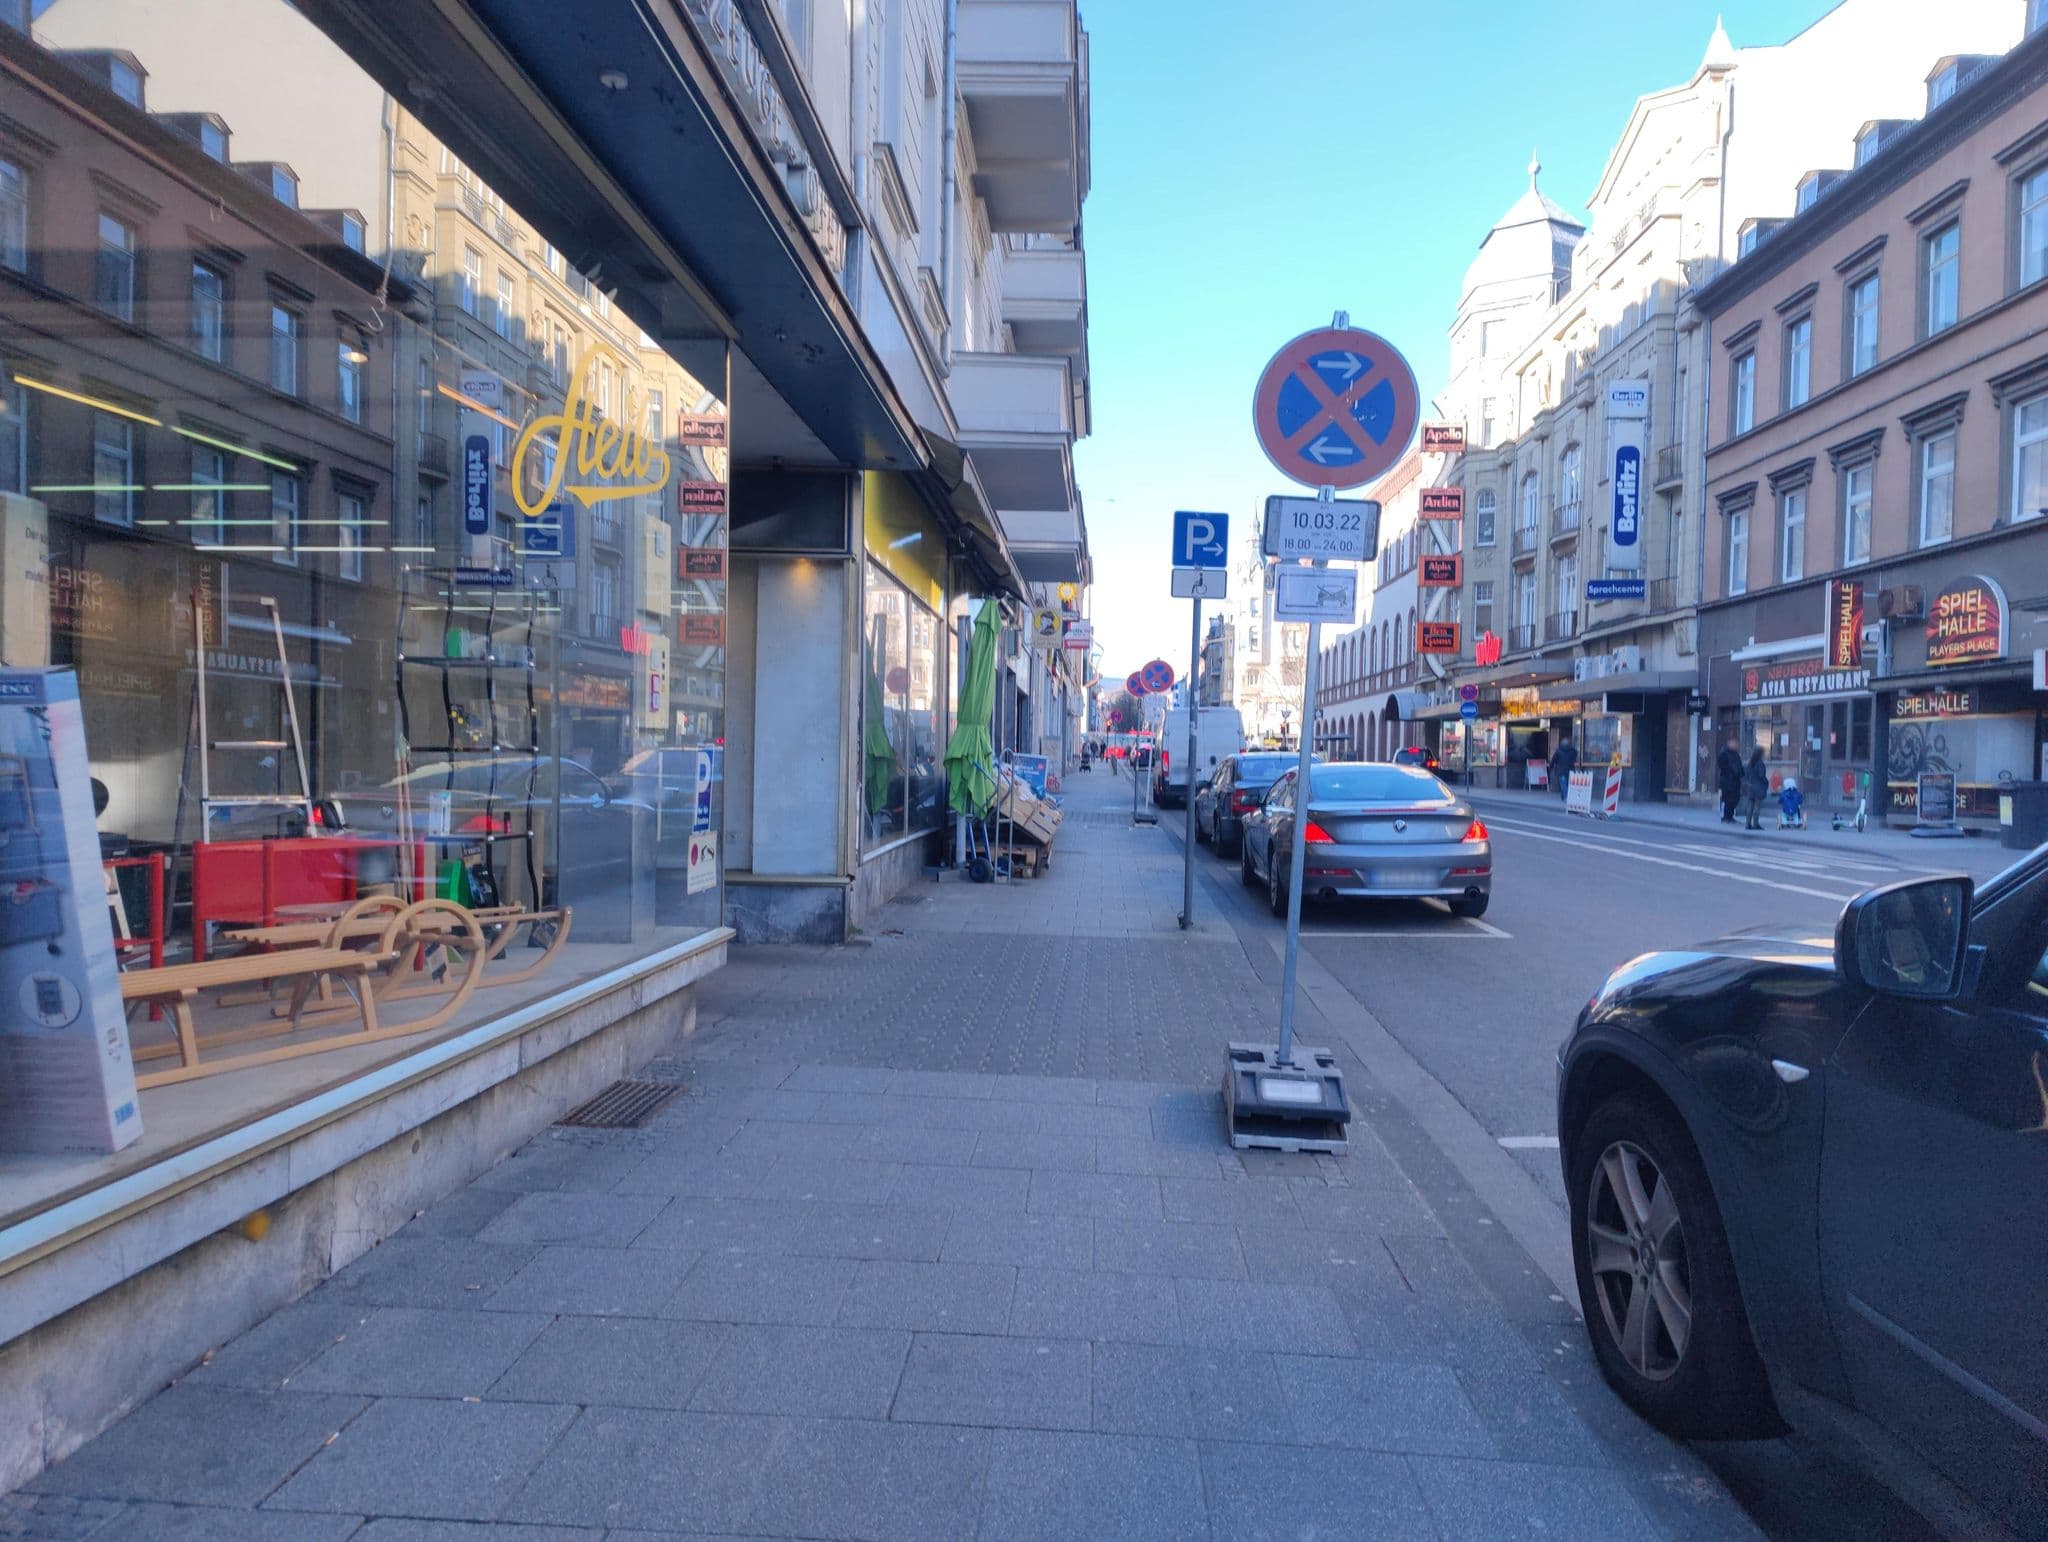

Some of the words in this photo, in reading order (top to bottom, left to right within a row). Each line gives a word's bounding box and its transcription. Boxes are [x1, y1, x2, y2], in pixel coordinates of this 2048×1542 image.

[1426, 428, 1462, 443] Apollo
[1617, 459, 1637, 533] Berlitz
[1292, 511, 1361, 531] 10.03.22
[1185, 518, 1216, 561] P
[1588, 584, 1644, 595] Sprachcenter
[1938, 588, 1987, 618] SPIEL
[1840, 583, 1853, 665] SPIELHALLE
[1938, 612, 1987, 638] HALLE
[1761, 680, 1785, 697] ASIA
[1789, 669, 1871, 695] RESTAURANT
[1896, 693, 1970, 716] SPIELHALLE
